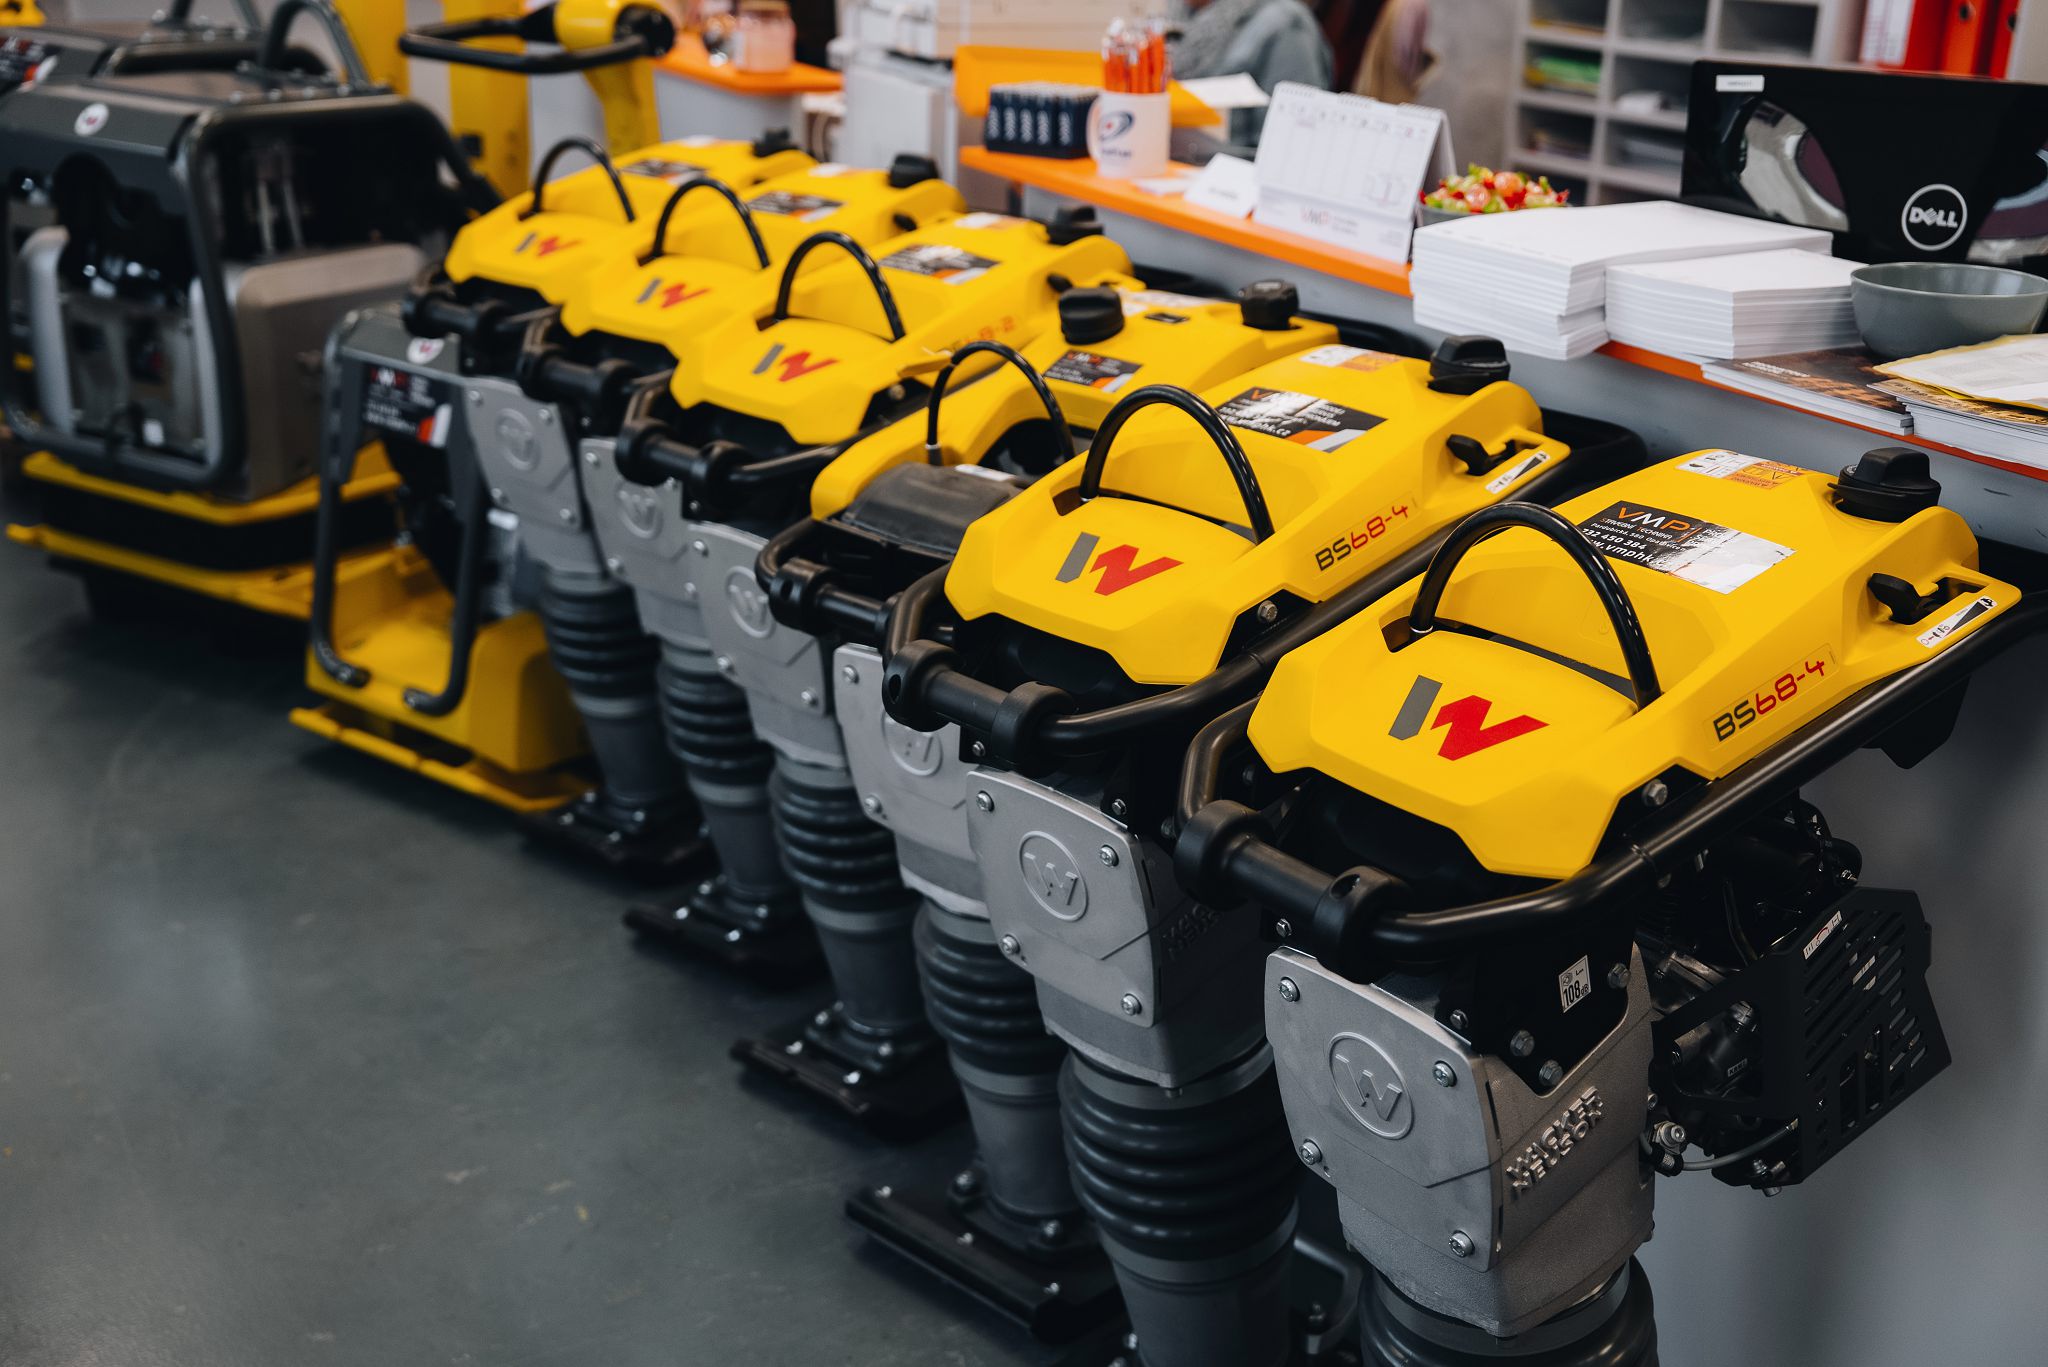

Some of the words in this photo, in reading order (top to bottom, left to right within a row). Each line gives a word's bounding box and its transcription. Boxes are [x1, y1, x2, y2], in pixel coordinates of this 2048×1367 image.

[1909, 206, 1959, 228] DELL
[1618, 506, 1691, 531] VMP
[1315, 505, 1408, 572] BS68-4
[1601, 534, 1624, 544] 450
[1623, 539, 1648, 550] 384
[1712, 661, 1825, 742] BS68-4
[1562, 980, 1581, 1007] 108
[1506, 1085, 1604, 1174] WACKER
